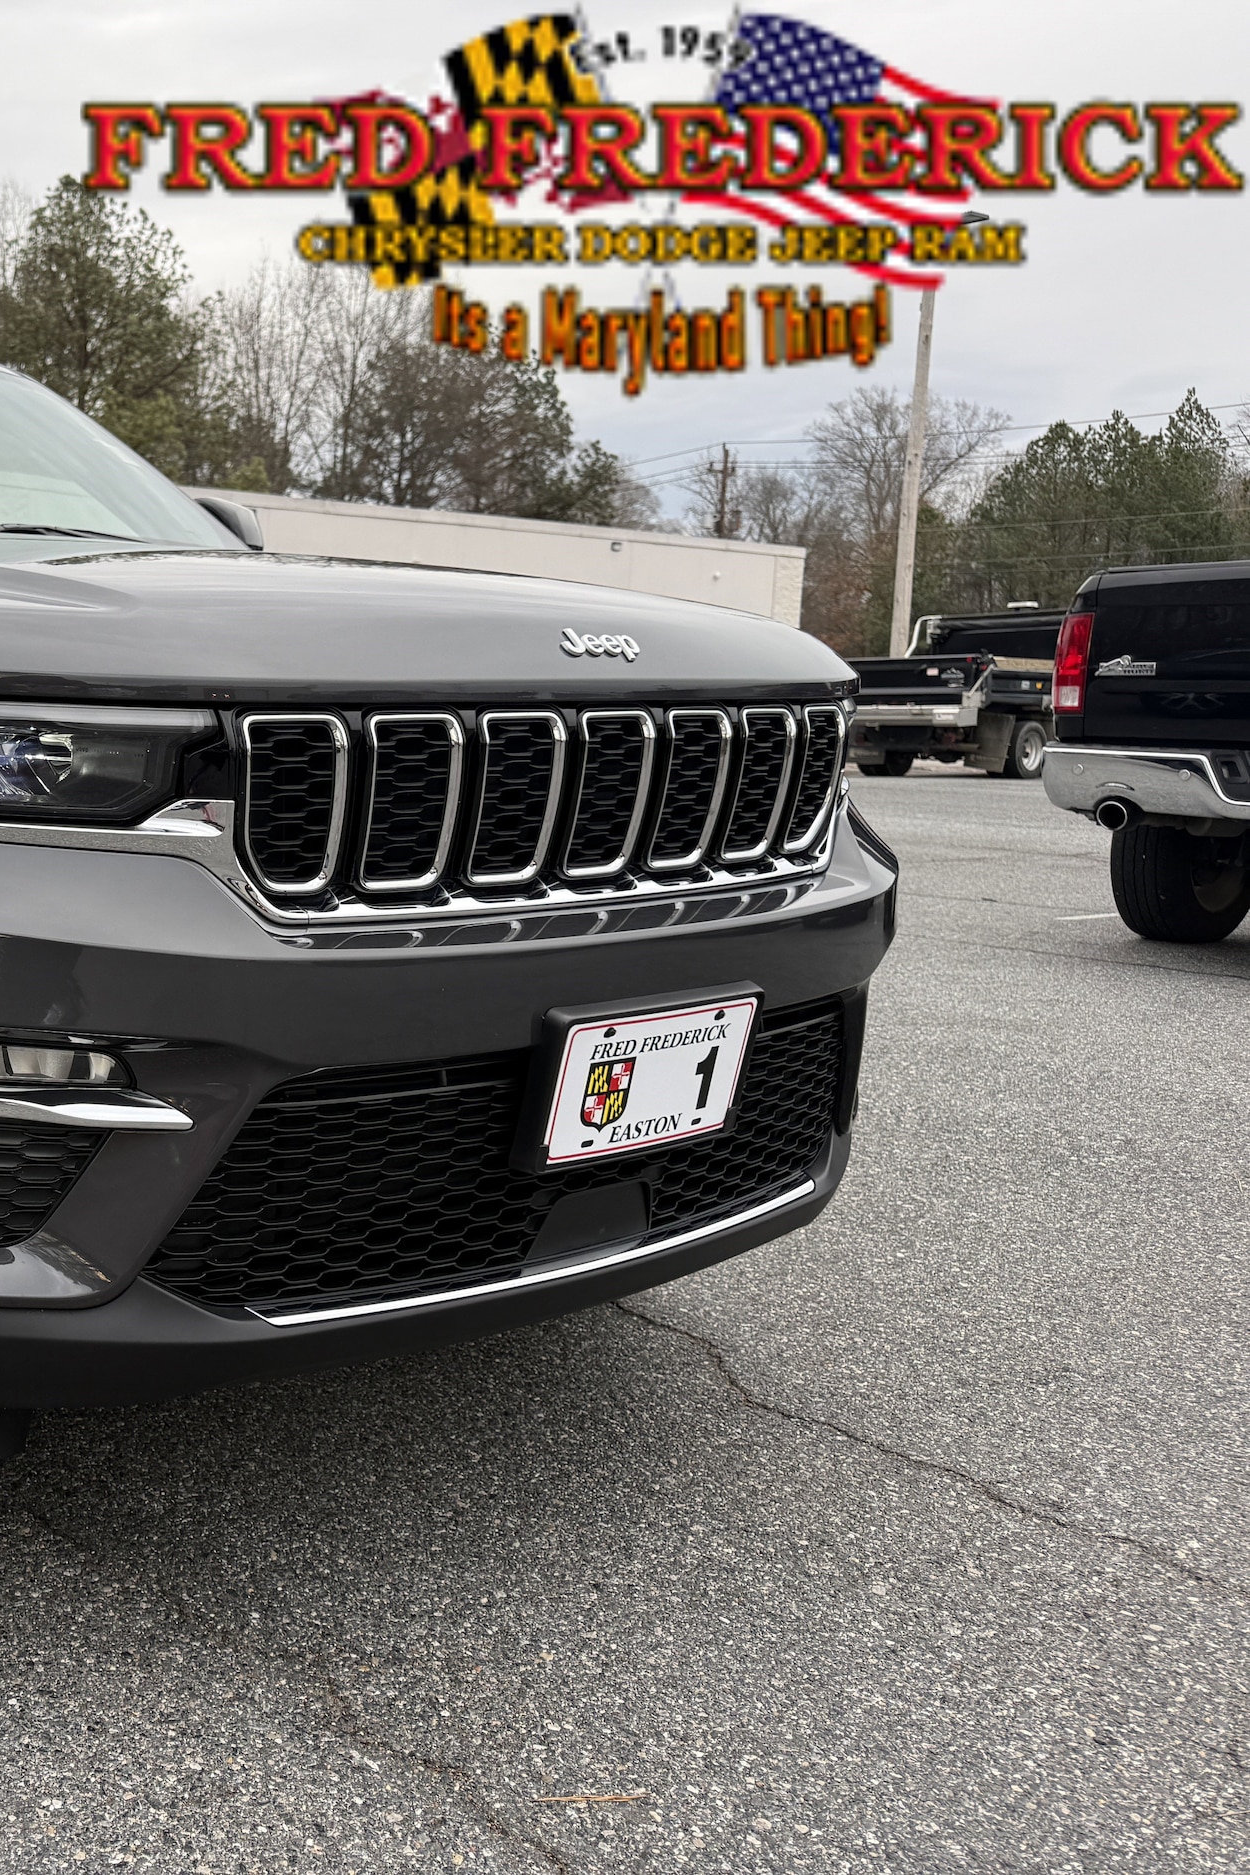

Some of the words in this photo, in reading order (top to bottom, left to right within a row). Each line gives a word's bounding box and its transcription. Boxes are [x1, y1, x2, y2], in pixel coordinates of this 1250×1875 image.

[559, 627, 640, 663] Jeep
[589, 1039, 638, 1061] FRED
[639, 1023, 732, 1054] FREDERICK
[695, 1045, 720, 1110] 1
[607, 1113, 683, 1144] EASTON
